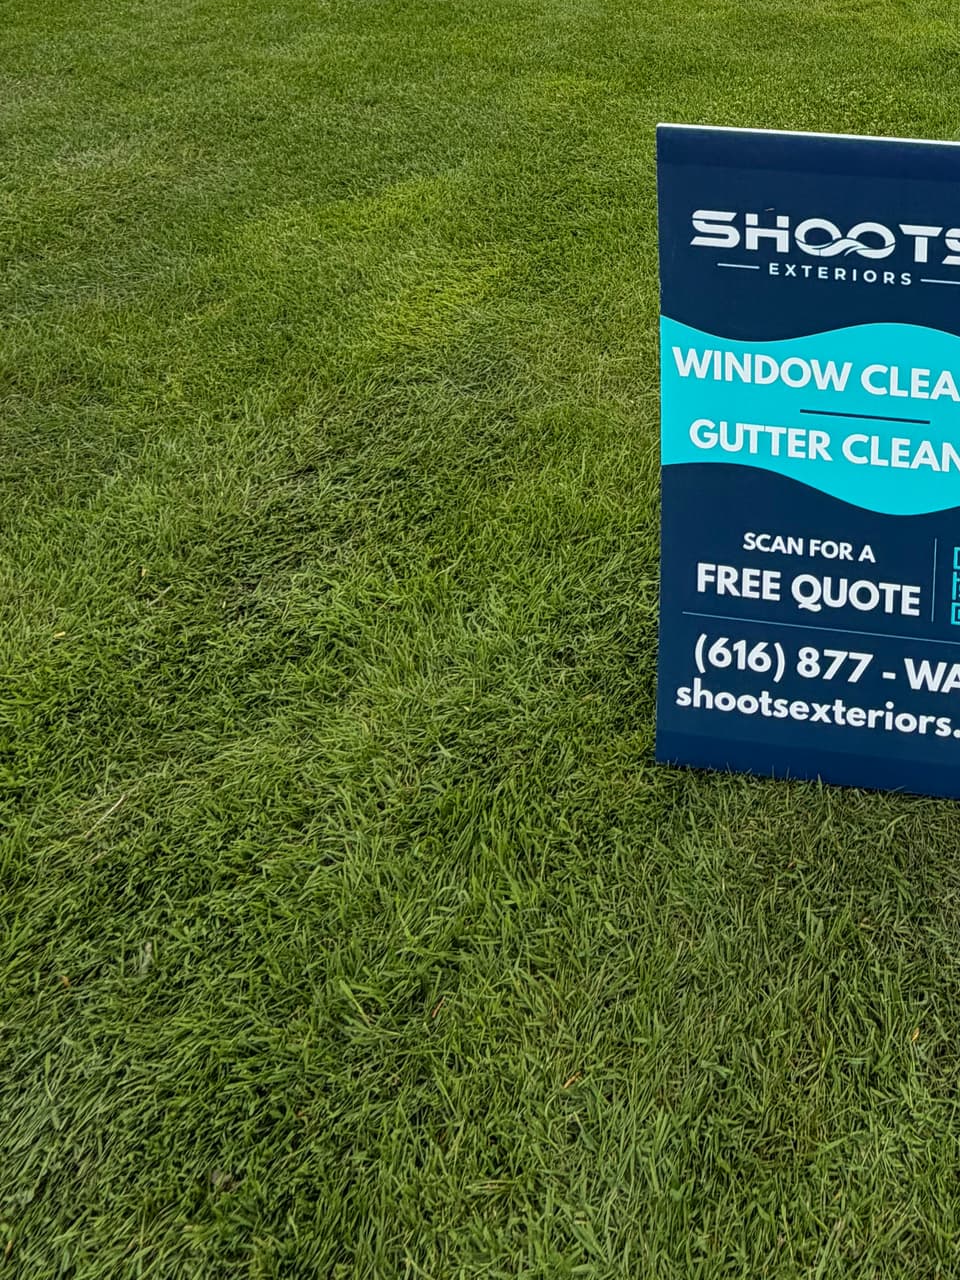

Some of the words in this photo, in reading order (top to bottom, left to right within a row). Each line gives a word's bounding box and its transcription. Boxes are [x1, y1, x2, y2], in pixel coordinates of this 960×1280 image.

[769, 262, 913, 286] EXTERIORS
[672, 346, 853, 392] WINDOW
[689, 419, 833, 461] GUTTER
[742, 532, 804, 556] SCAN
[809, 539, 854, 561] FOR
[858, 544, 876, 563] A
[697, 562, 781, 601] FREE
[791, 574, 921, 617] QUOTE
[694, 633, 786, 683] (616)
[796, 646, 874, 683] 877
